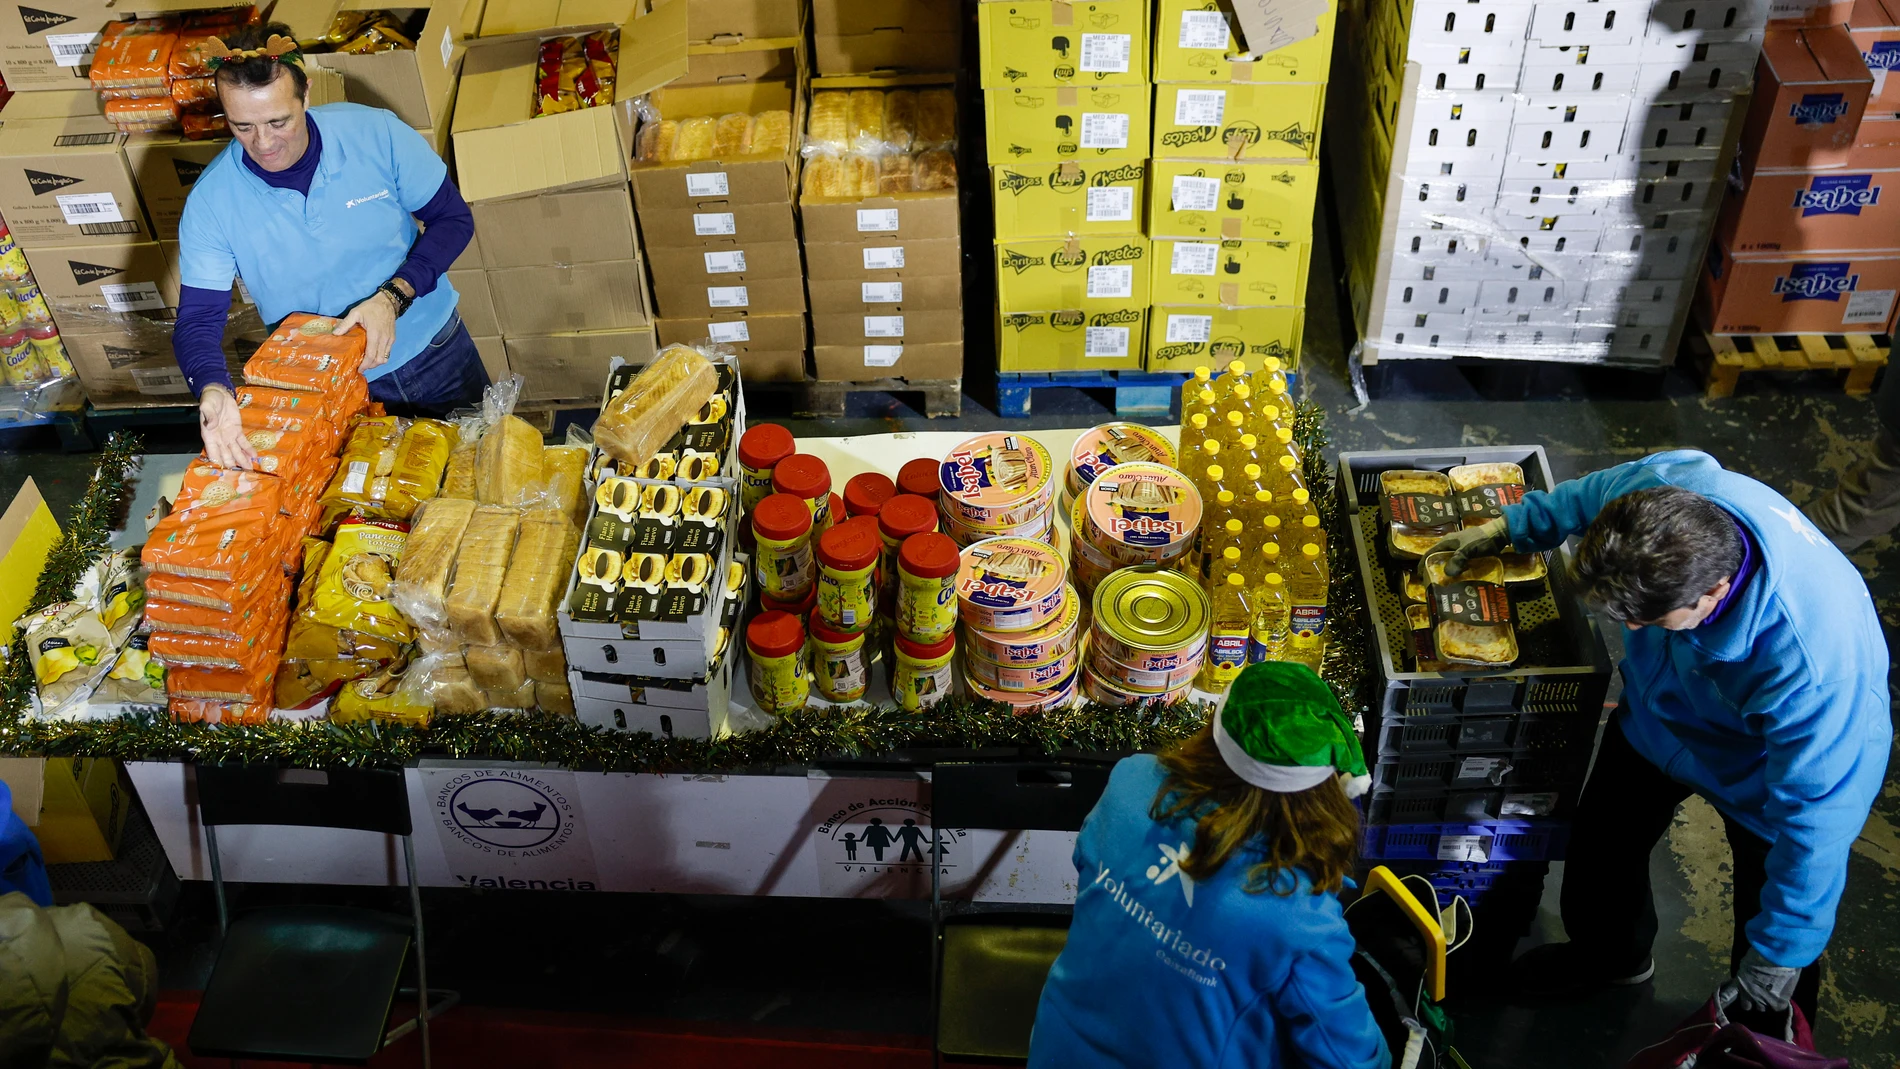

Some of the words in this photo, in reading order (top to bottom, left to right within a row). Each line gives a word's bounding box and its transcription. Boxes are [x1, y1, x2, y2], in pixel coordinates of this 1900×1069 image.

[1789, 102, 1849, 119] Isabel
[1162, 126, 1217, 147] Cheetos
[1268, 131, 1315, 142] Doritos
[1000, 177, 1042, 190] Doritos
[1091, 165, 1145, 187] Cheetos
[356, 189, 389, 204] Voluntariado
[1791, 185, 1882, 211] Isabel
[1002, 257, 1044, 268] Doritos
[1093, 245, 1142, 266] Cheetos
[1771, 272, 1860, 298] Isabel
[1004, 315, 1045, 327] Doritos
[1090, 309, 1140, 327] Cheetos
[1156, 342, 1205, 360] Cheetos
[952, 450, 982, 500] Isabel
[956, 501, 992, 518] Isabel
[606, 522, 616, 541] Huevo
[1110, 517, 1184, 535] Isabel
[359, 531, 406, 543] Panecillo
[368, 540, 405, 549] tostad
[648, 527, 658, 546] Huevo
[683, 534, 691, 547] Flan
[690, 529, 700, 547] Huevo
[961, 578, 1037, 602] Isabel
[589, 593, 599, 613] Huevo
[625, 600, 633, 613] Flan
[633, 595, 643, 614] Huevo
[669, 601, 677, 614] Flan
[676, 595, 686, 614] Huevo
[1003, 646, 1044, 659] Isabel
[1029, 660, 1066, 681] Isabel
[1143, 657, 1182, 669] Isabel
[437, 773, 471, 808] BANCOS
[474, 769, 493, 778] DE
[500, 770, 572, 811] ALIMENTOS
[817, 809, 847, 835] Banco
[848, 801, 865, 812] de
[868, 798, 919, 808] Acción
[442, 819, 492, 853] BANCOS
[497, 850, 516, 858] DE
[522, 822, 574, 858] ALIMENTOS
[456, 875, 596, 891] Valencia
[1095, 860, 1227, 971] Voluntariado
[1156, 949, 1218, 988] CaixaBank
